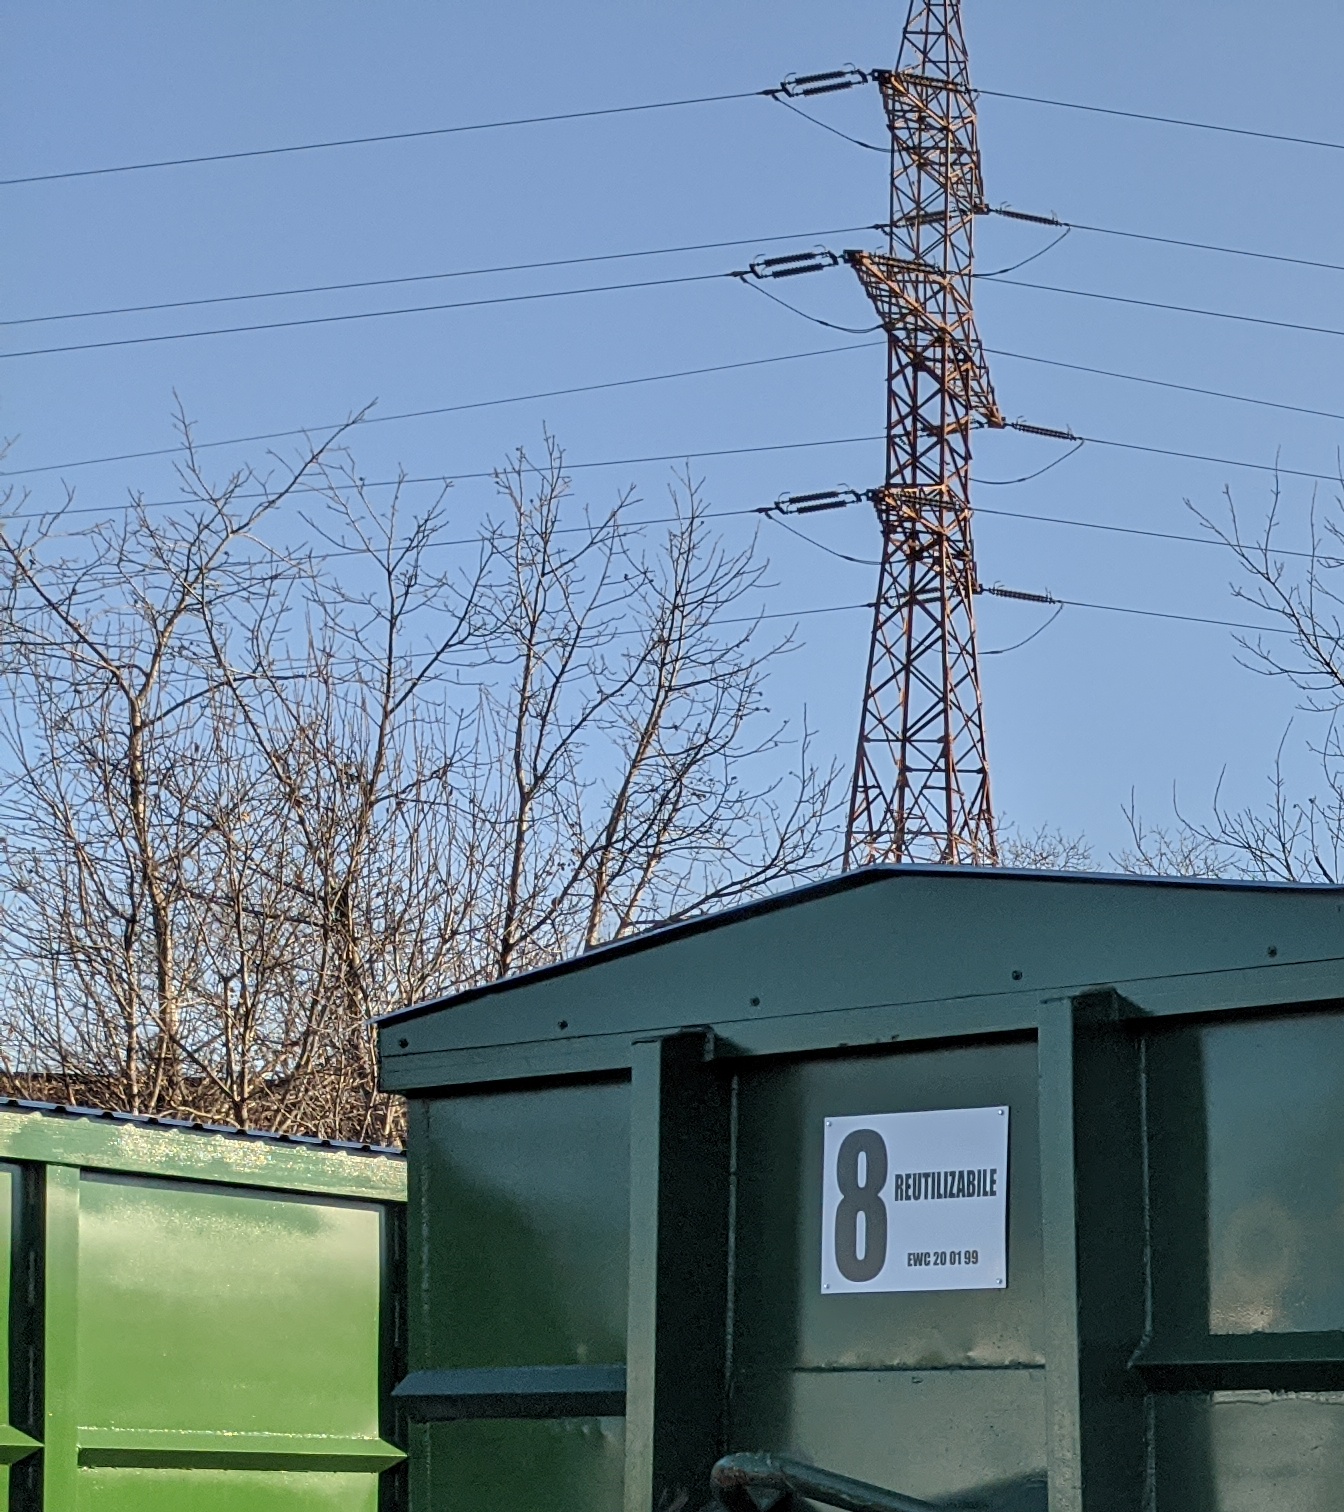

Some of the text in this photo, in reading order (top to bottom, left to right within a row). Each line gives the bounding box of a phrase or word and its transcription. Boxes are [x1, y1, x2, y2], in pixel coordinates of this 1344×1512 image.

[894, 1168, 998, 1201] REUTILIZABILE
[834, 1128, 888, 1282] 8
[907, 1250, 979, 1267] EWC 20 01 99
